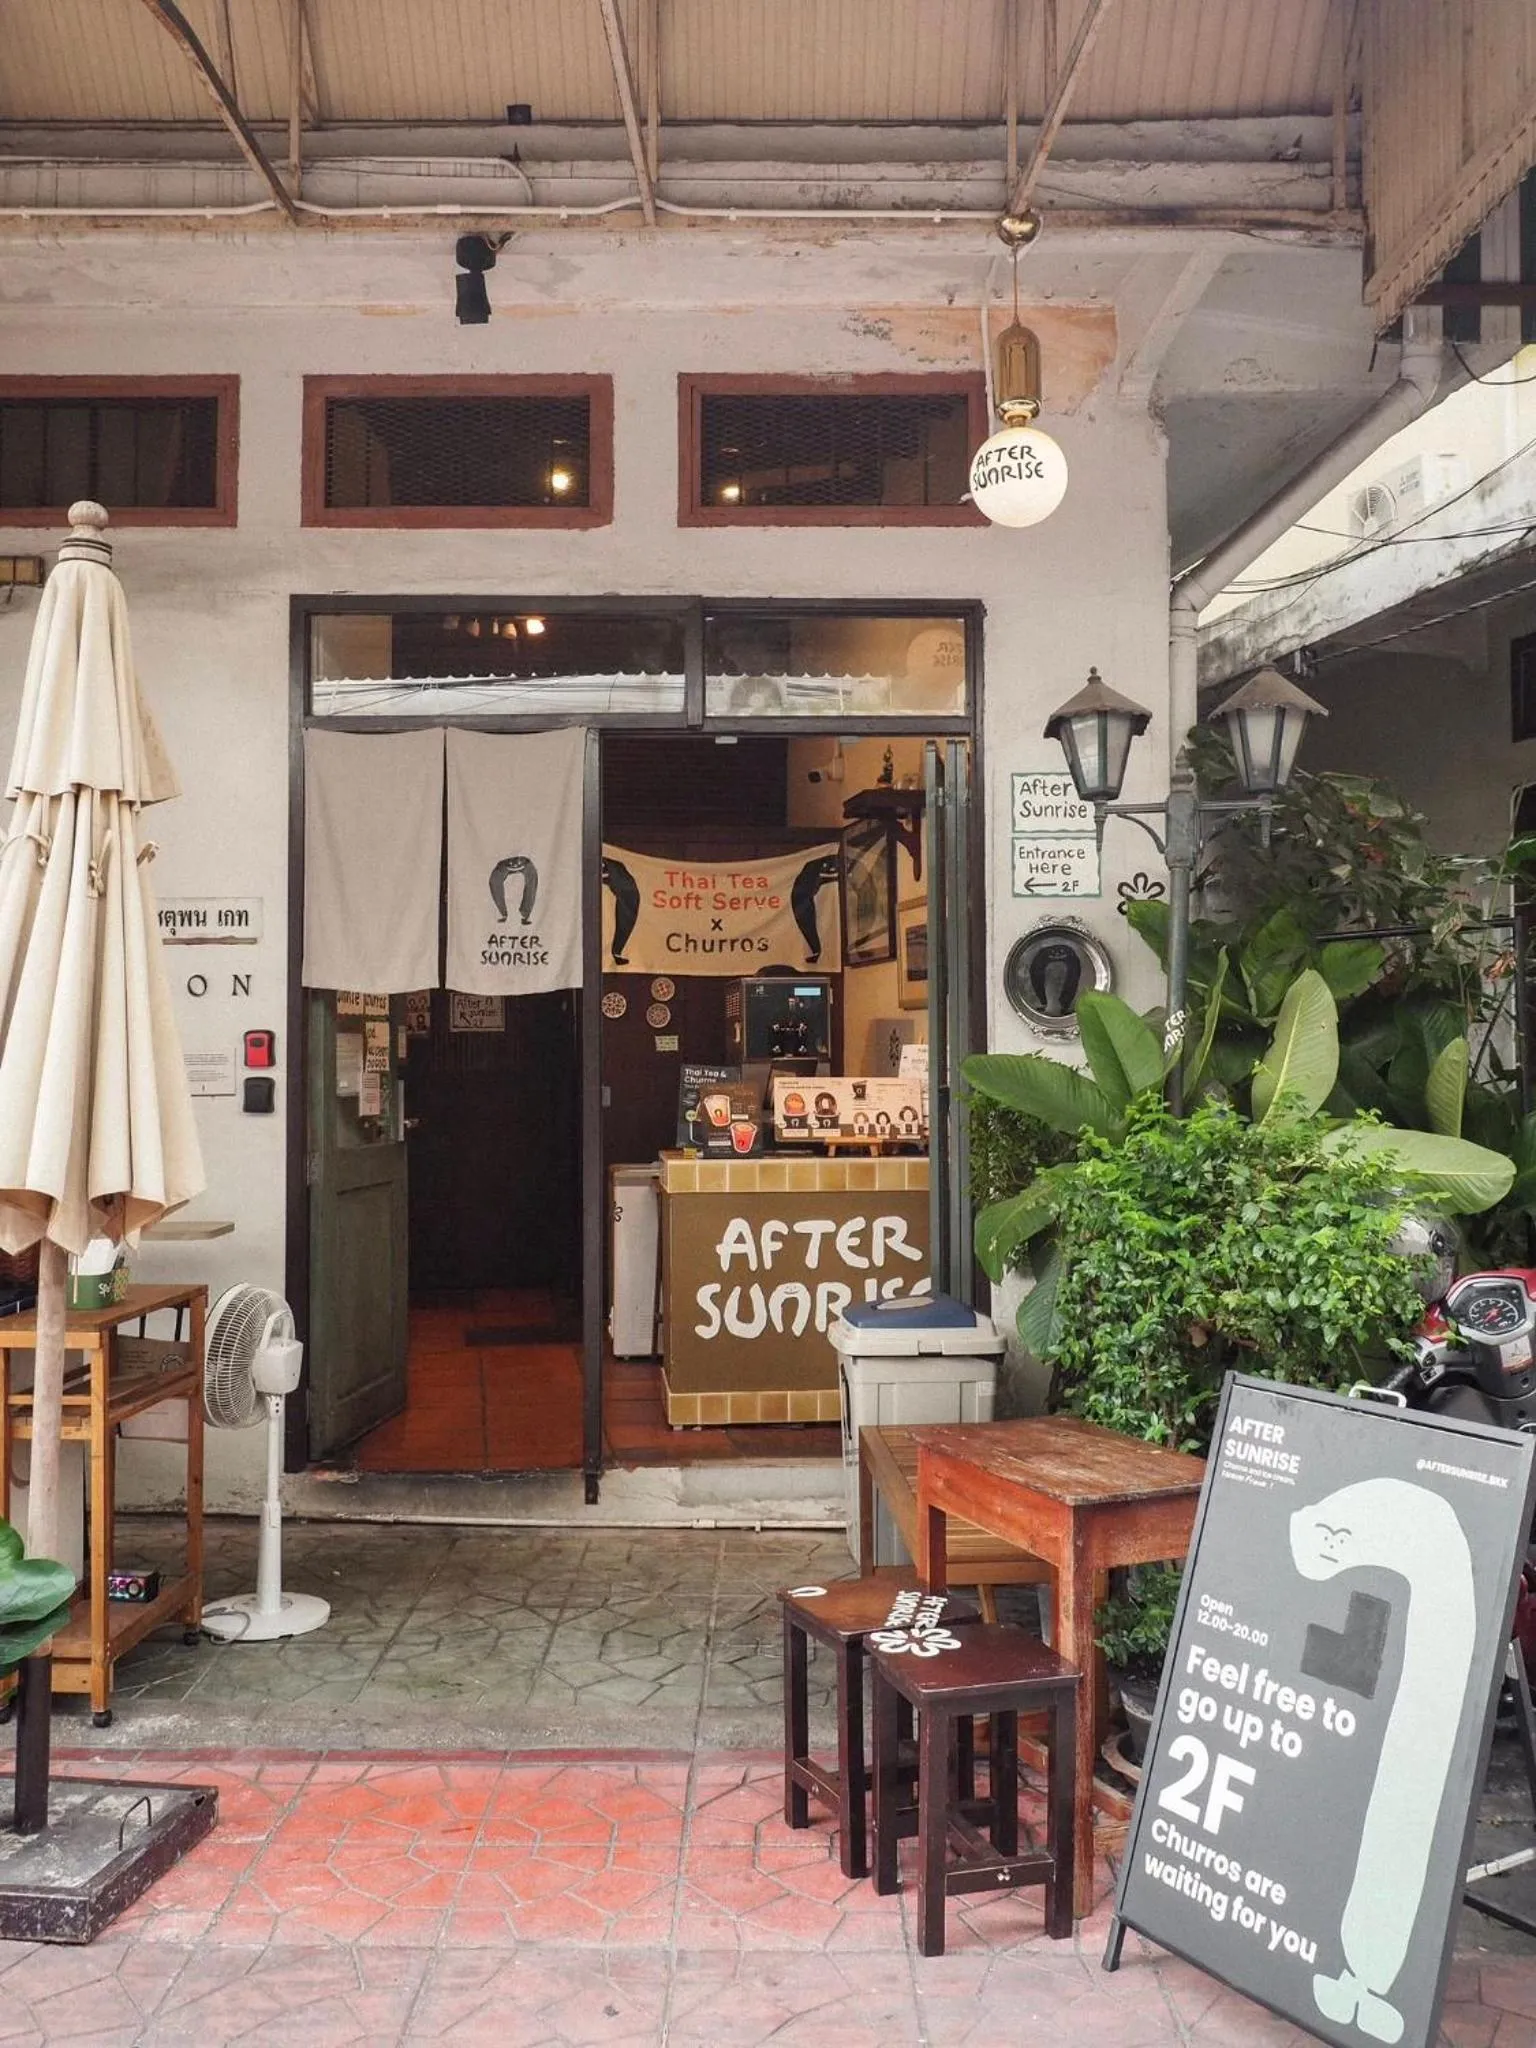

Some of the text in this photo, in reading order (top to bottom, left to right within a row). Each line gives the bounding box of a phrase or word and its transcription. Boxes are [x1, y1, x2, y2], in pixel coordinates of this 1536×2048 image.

[976, 445, 1037, 471] AFTER
[973, 461, 1044, 492] SUNRISE
[1019, 778, 1073, 797] After
[1019, 800, 1088, 819] Sunrise
[1018, 846, 1086, 860] Entrance
[664, 871, 769, 890] Thai Tea
[1028, 862, 1072, 875] Here
[1061, 880, 1080, 892] 2F
[652, 890, 782, 911] Soft Serve
[487, 934, 543, 949] AFTER
[665, 932, 769, 953] Churros
[480, 950, 549, 966] SUNRISE
[715, 1215, 923, 1272] AFTER
[1228, 1416, 1285, 1444] AFTER
[1224, 1438, 1301, 1474] SUNRISE
[1200, 1594, 1234, 1616] Open
[1197, 1609, 1269, 1647] 12.00-20.00
[1186, 1644, 1356, 1737] Feel free to
[1177, 1687, 1303, 1758] go up to
[1158, 1734, 1257, 1835] 2F
[1151, 1818, 1287, 1905] Churros are
[1144, 1853, 1318, 1964] waiting for you
